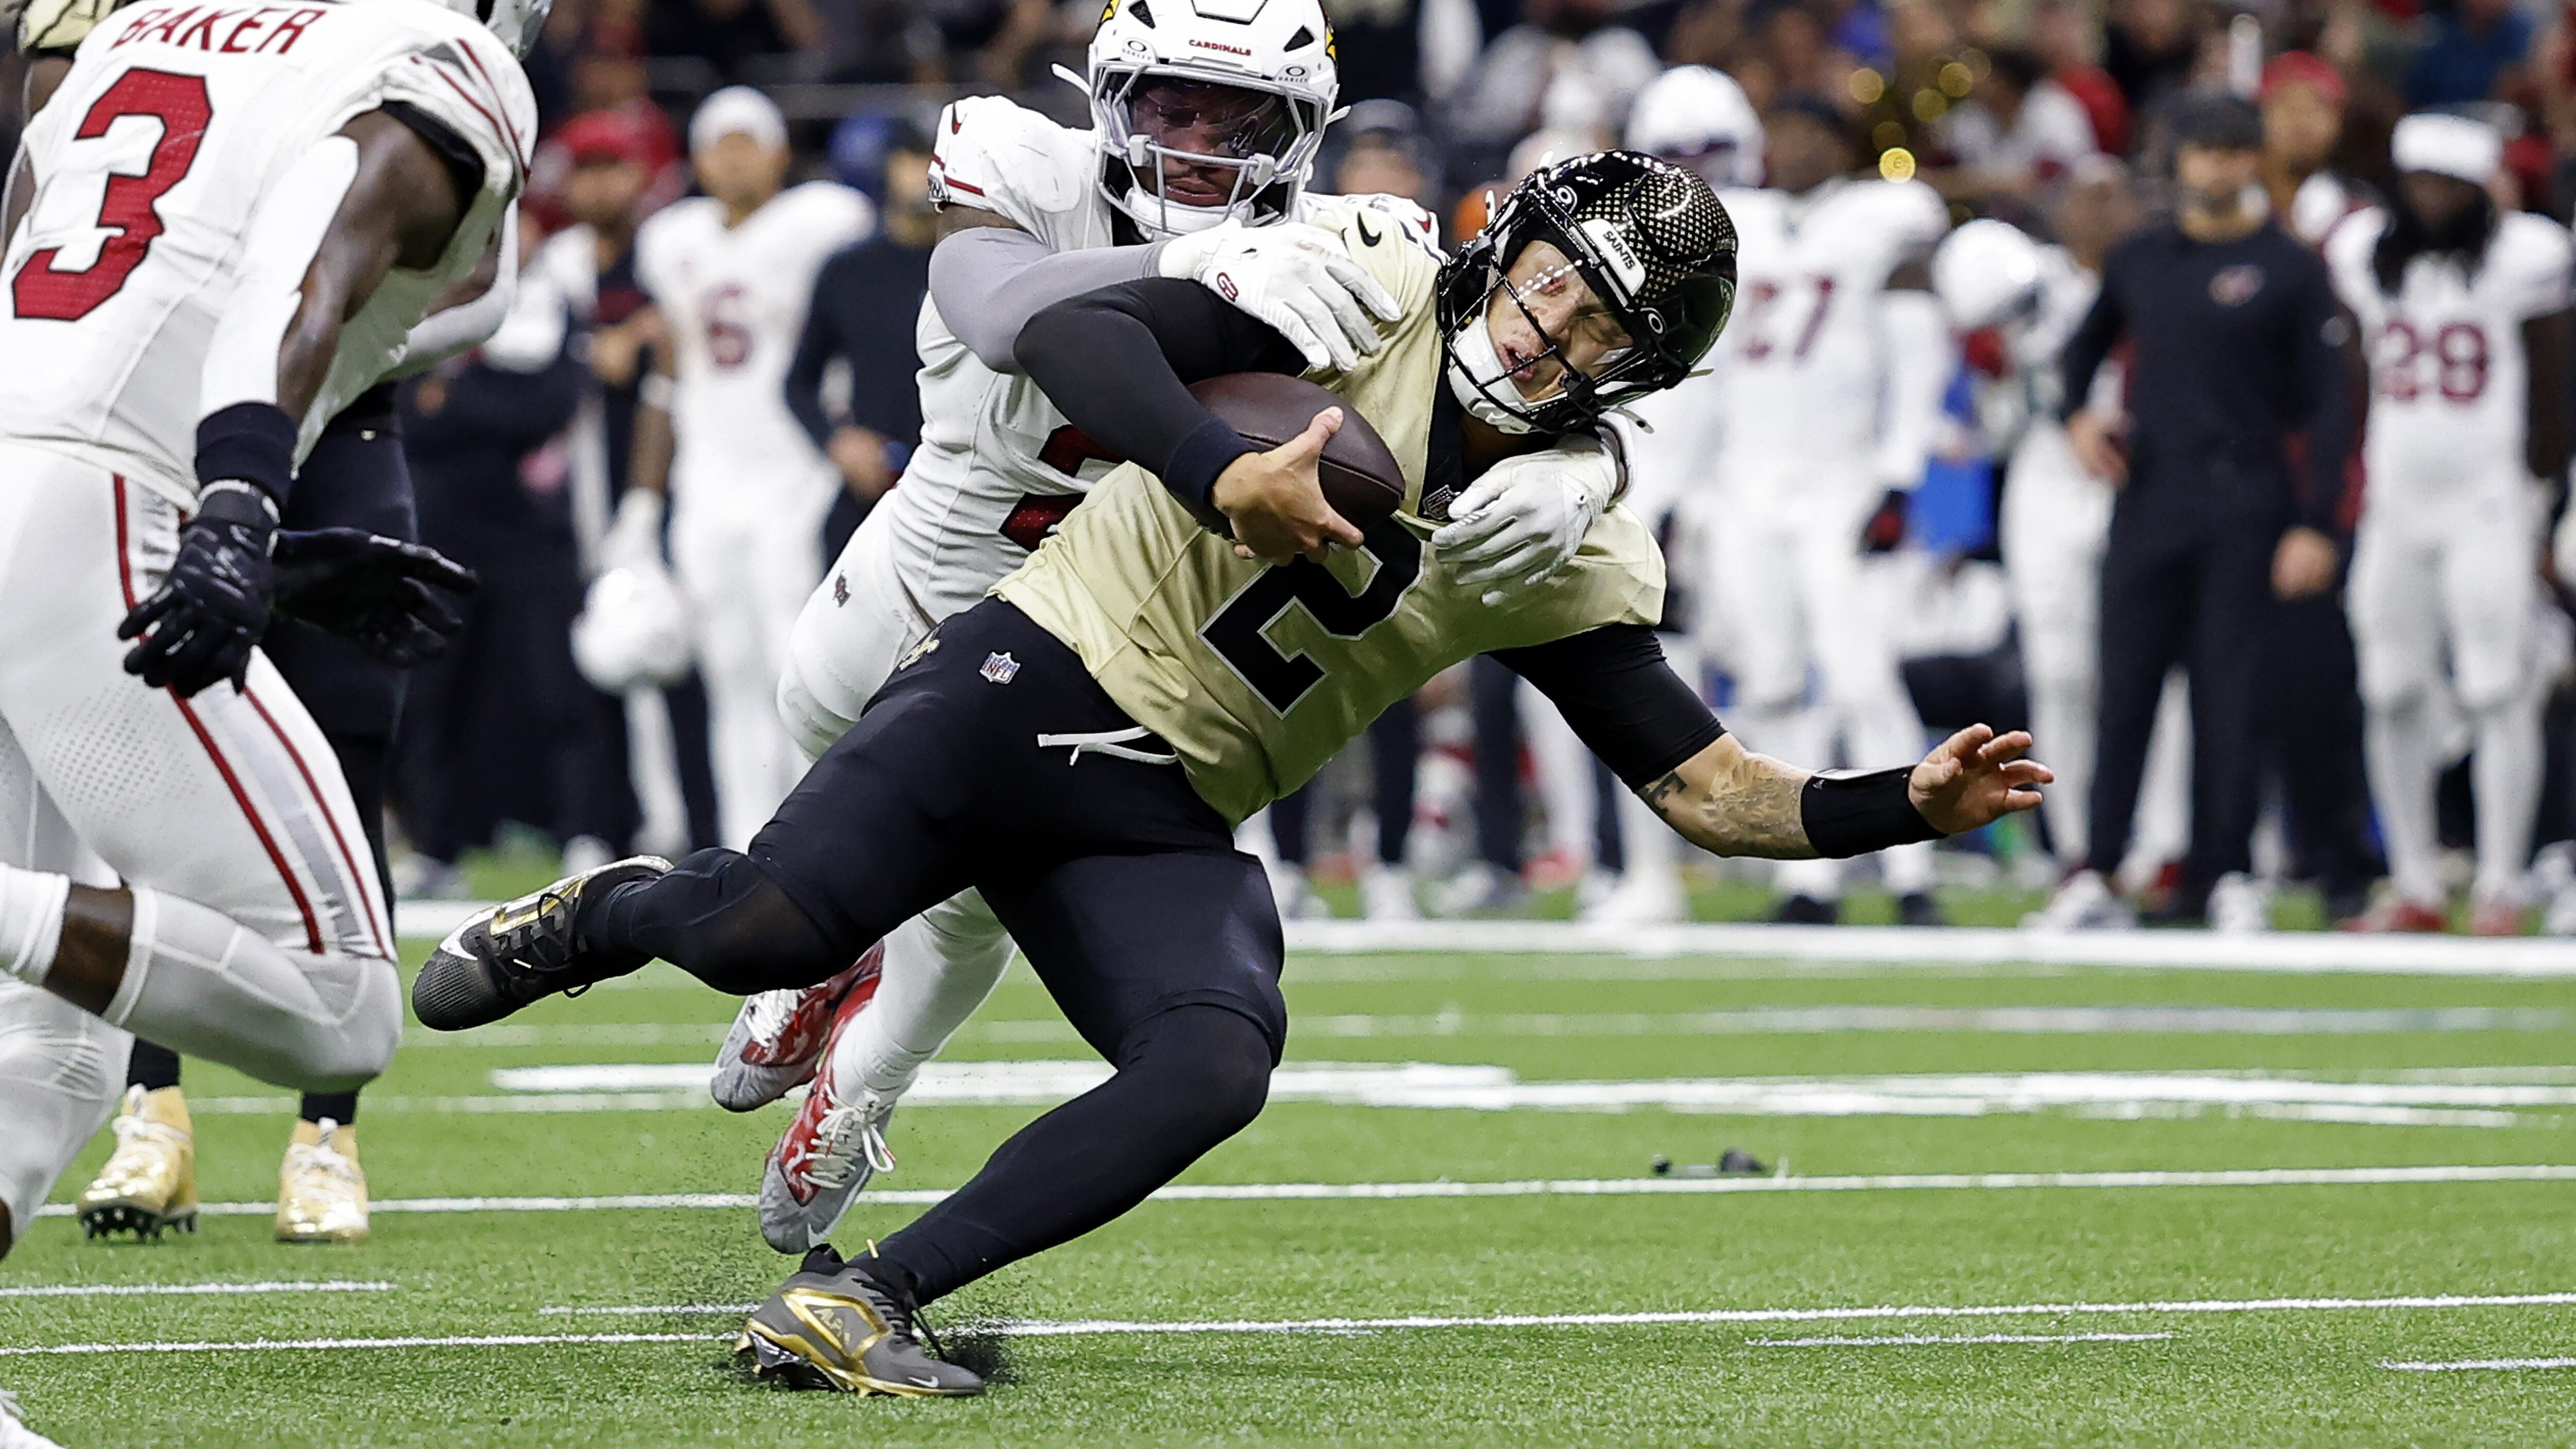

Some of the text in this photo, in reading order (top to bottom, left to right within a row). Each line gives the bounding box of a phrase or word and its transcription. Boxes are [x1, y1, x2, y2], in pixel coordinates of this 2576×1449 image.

[109, 5, 328, 54] BAKER
[1189, 39, 1251, 56] CARDINALS
[12, 66, 213, 321] 3
[1603, 231, 1636, 270] SAINTS
[2376, 318, 2487, 401] 29
[1196, 513, 1427, 720] 2
[985, 662, 1008, 679] NFL
